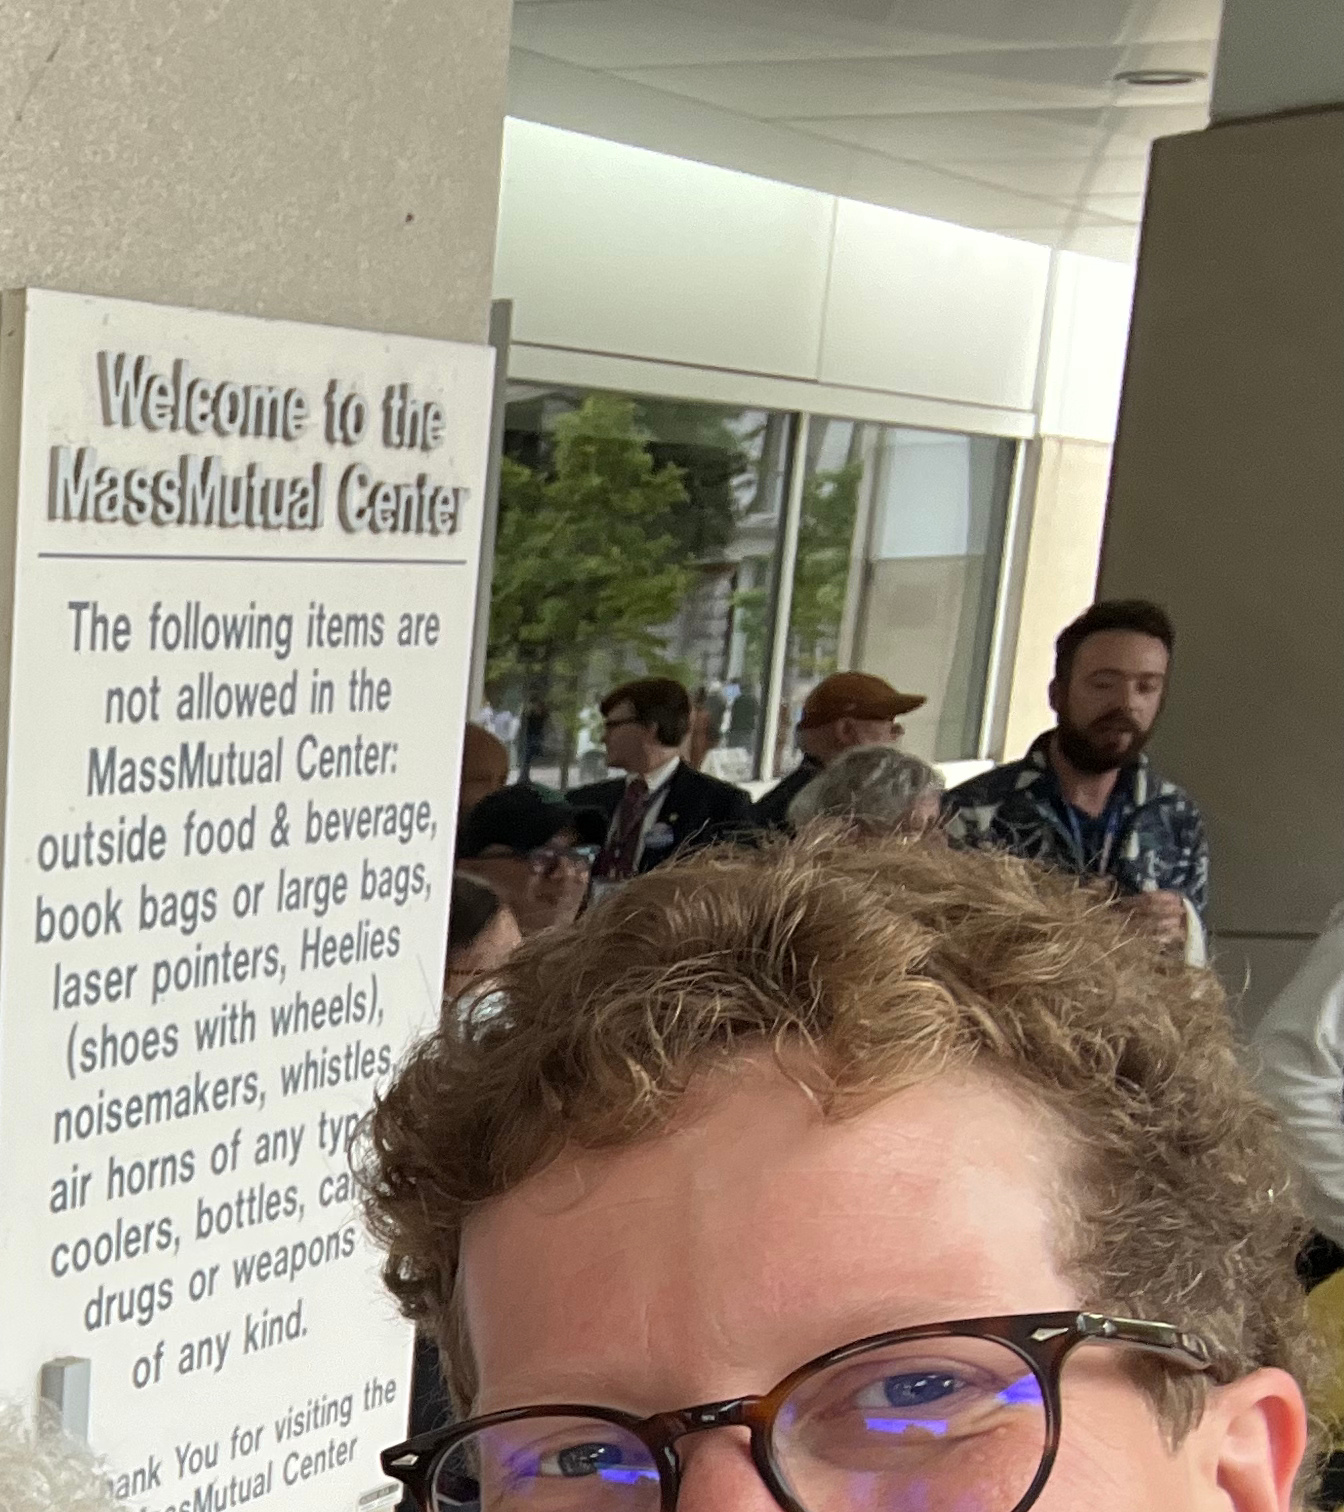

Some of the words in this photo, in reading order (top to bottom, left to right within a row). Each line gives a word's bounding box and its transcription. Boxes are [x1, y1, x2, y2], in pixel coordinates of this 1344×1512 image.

[97, 349, 311, 443] Welcome
[323, 378, 369, 448] to
[381, 382, 446, 452] the
[47, 445, 327, 532] MassMutual
[337, 462, 471, 537] Center
[68, 600, 132, 654] The
[148, 601, 294, 660] following
[306, 601, 385, 650] items
[397, 610, 441, 648] are
[104, 675, 162, 725] not
[176, 668, 298, 721] allowed
[311, 668, 335, 716] in
[348, 667, 393, 714] the
[86, 736, 284, 797] MassMutual
[296, 733, 400, 782] Center:
[37, 812, 168, 872] outside
[183, 804, 257, 858] food
[269, 801, 291, 847] &
[305, 798, 439, 844] beverage,
[34, 887, 123, 944] book
[139, 880, 218, 936] bags
[233, 880, 265, 918] or
[277, 866, 348, 917] large
[359, 857, 433, 908] bags,
[52, 956, 138, 1011] laser
[152, 938, 289, 1004] pointers,
[300, 920, 403, 972] Heelies
[65, 1020, 180, 1082] (shoes
[194, 1000, 257, 1053] with
[270, 973, 387, 1041] wheels),
[53, 1067, 268, 1145] noisemakers,
[50, 1166, 92, 1214] air
[106, 1148, 196, 1202] horns
[211, 1128, 242, 1176] of
[254, 1121, 305, 1169] any
[317, 1111, 360, 1158] typ
[50, 1217, 182, 1279] coolers,
[194, 1181, 306, 1242] bottles,
[83, 1275, 174, 1333] drugs
[188, 1263, 221, 1302] or
[232, 1225, 357, 1292] weapons
[131, 1340, 166, 1390] of
[178, 1327, 232, 1385] any
[242, 1299, 310, 1356] kind.
[108, 1454, 163, 1502] ank
[174, 1442, 220, 1483] You
[230, 1420, 264, 1460] for
[274, 1391, 354, 1446] visiting
[362, 1376, 398, 1412] the
[282, 1433, 359, 1485] Center
